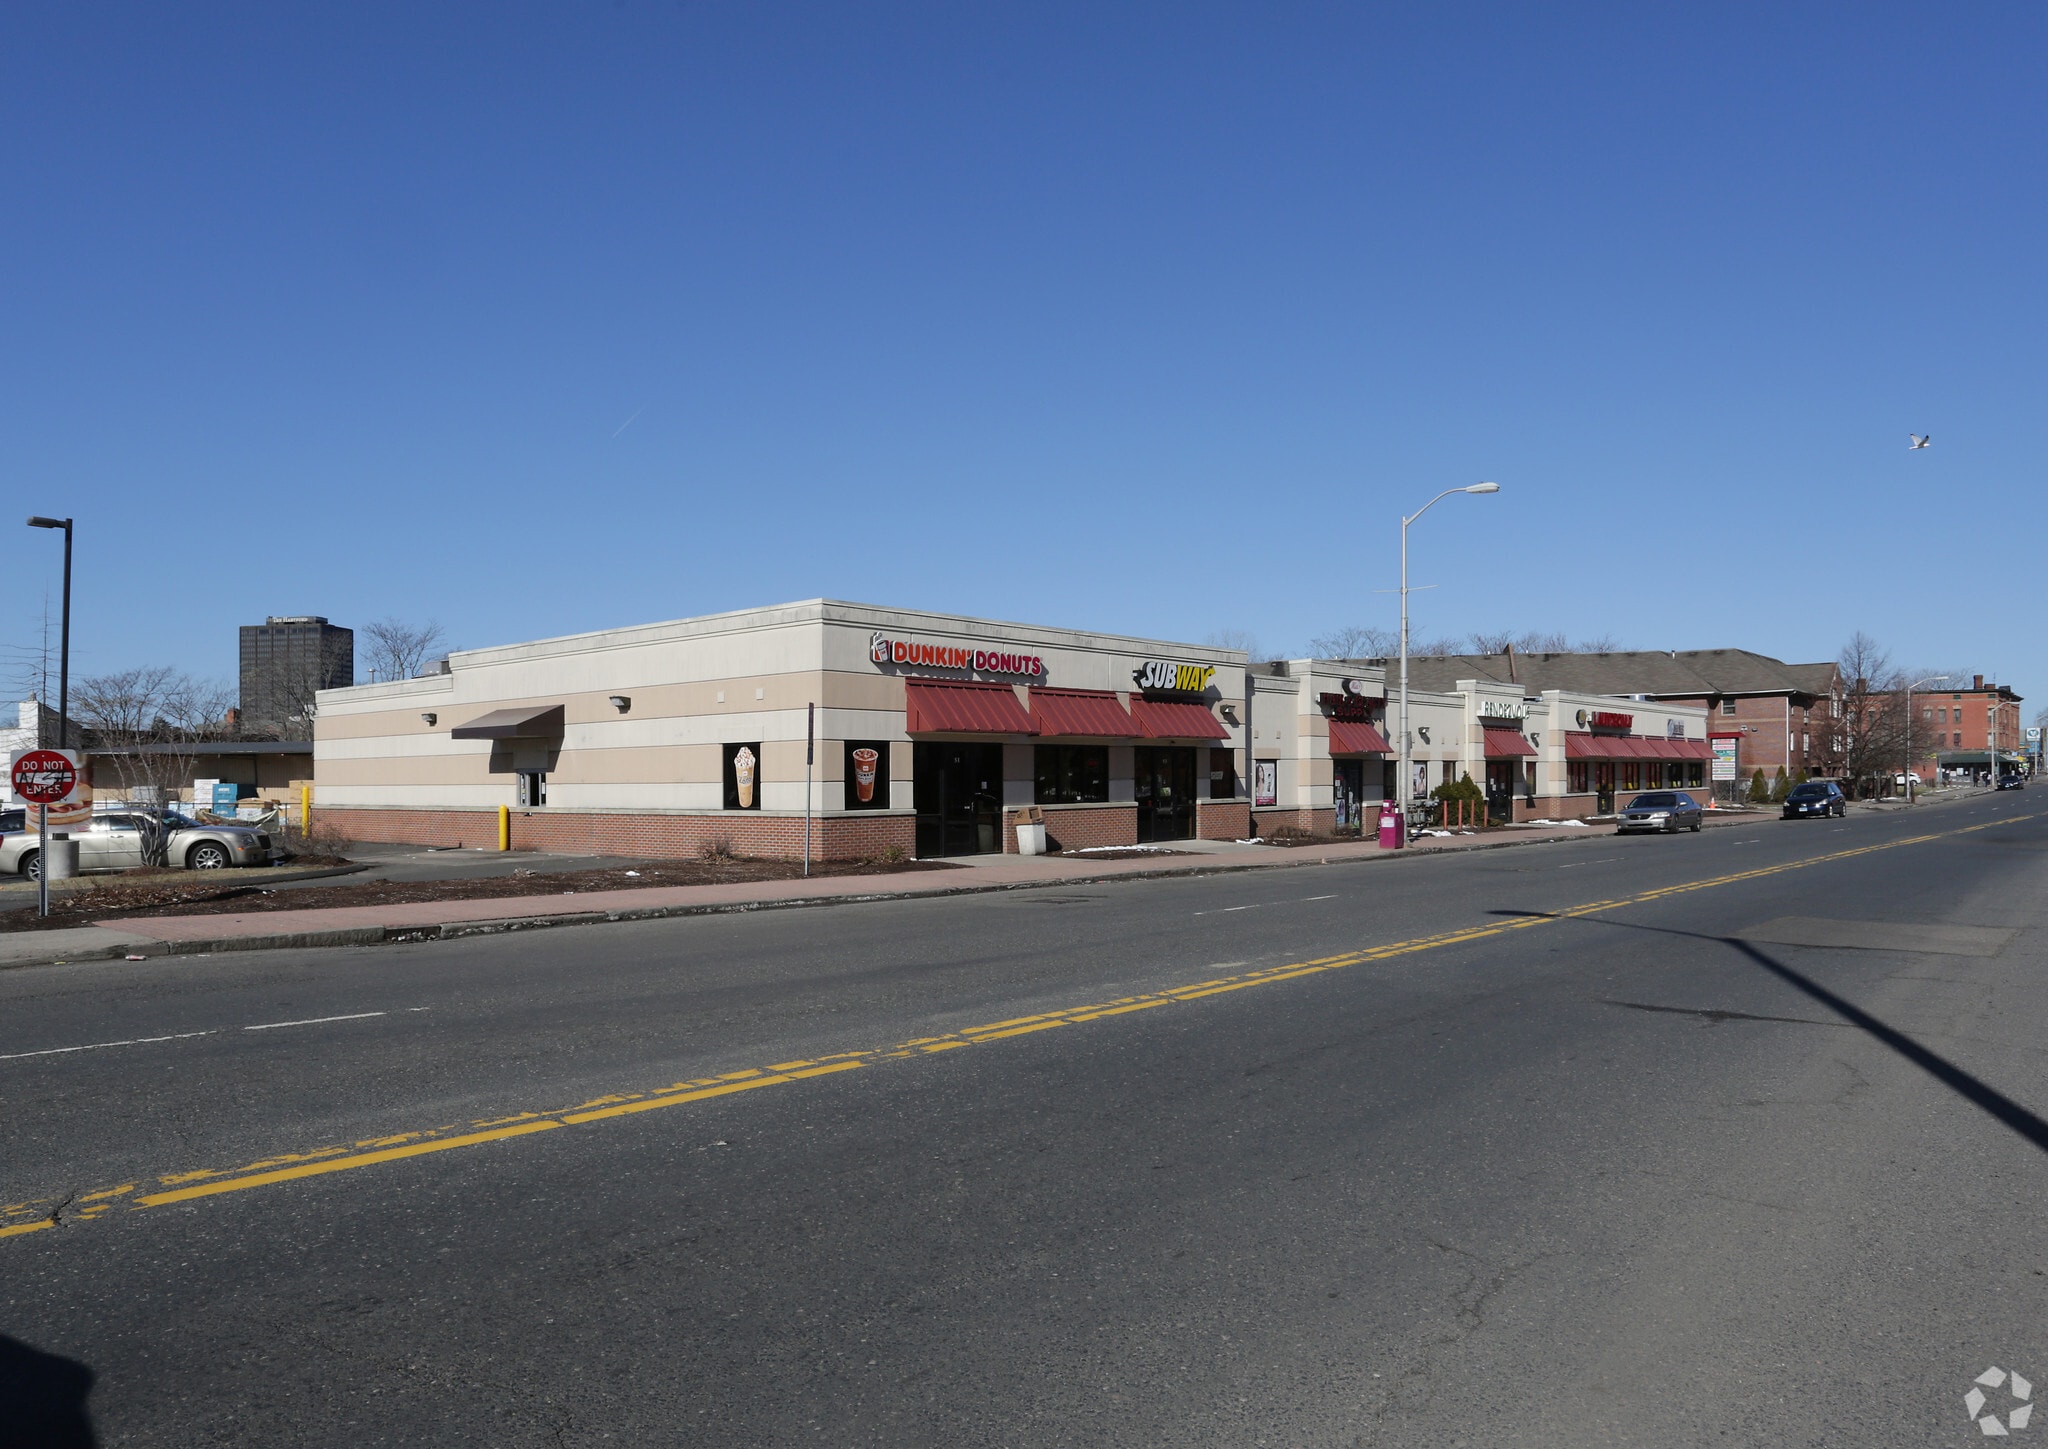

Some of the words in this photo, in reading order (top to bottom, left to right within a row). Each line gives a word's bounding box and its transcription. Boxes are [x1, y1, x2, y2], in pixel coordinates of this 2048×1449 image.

[893, 641, 972, 668] DUNKIN'
[975, 650, 1041, 676] DONUTS
[1139, 661, 1216, 692] SUBWAY
[22, 760, 38, 771] DO
[43, 760, 65, 770] NOT
